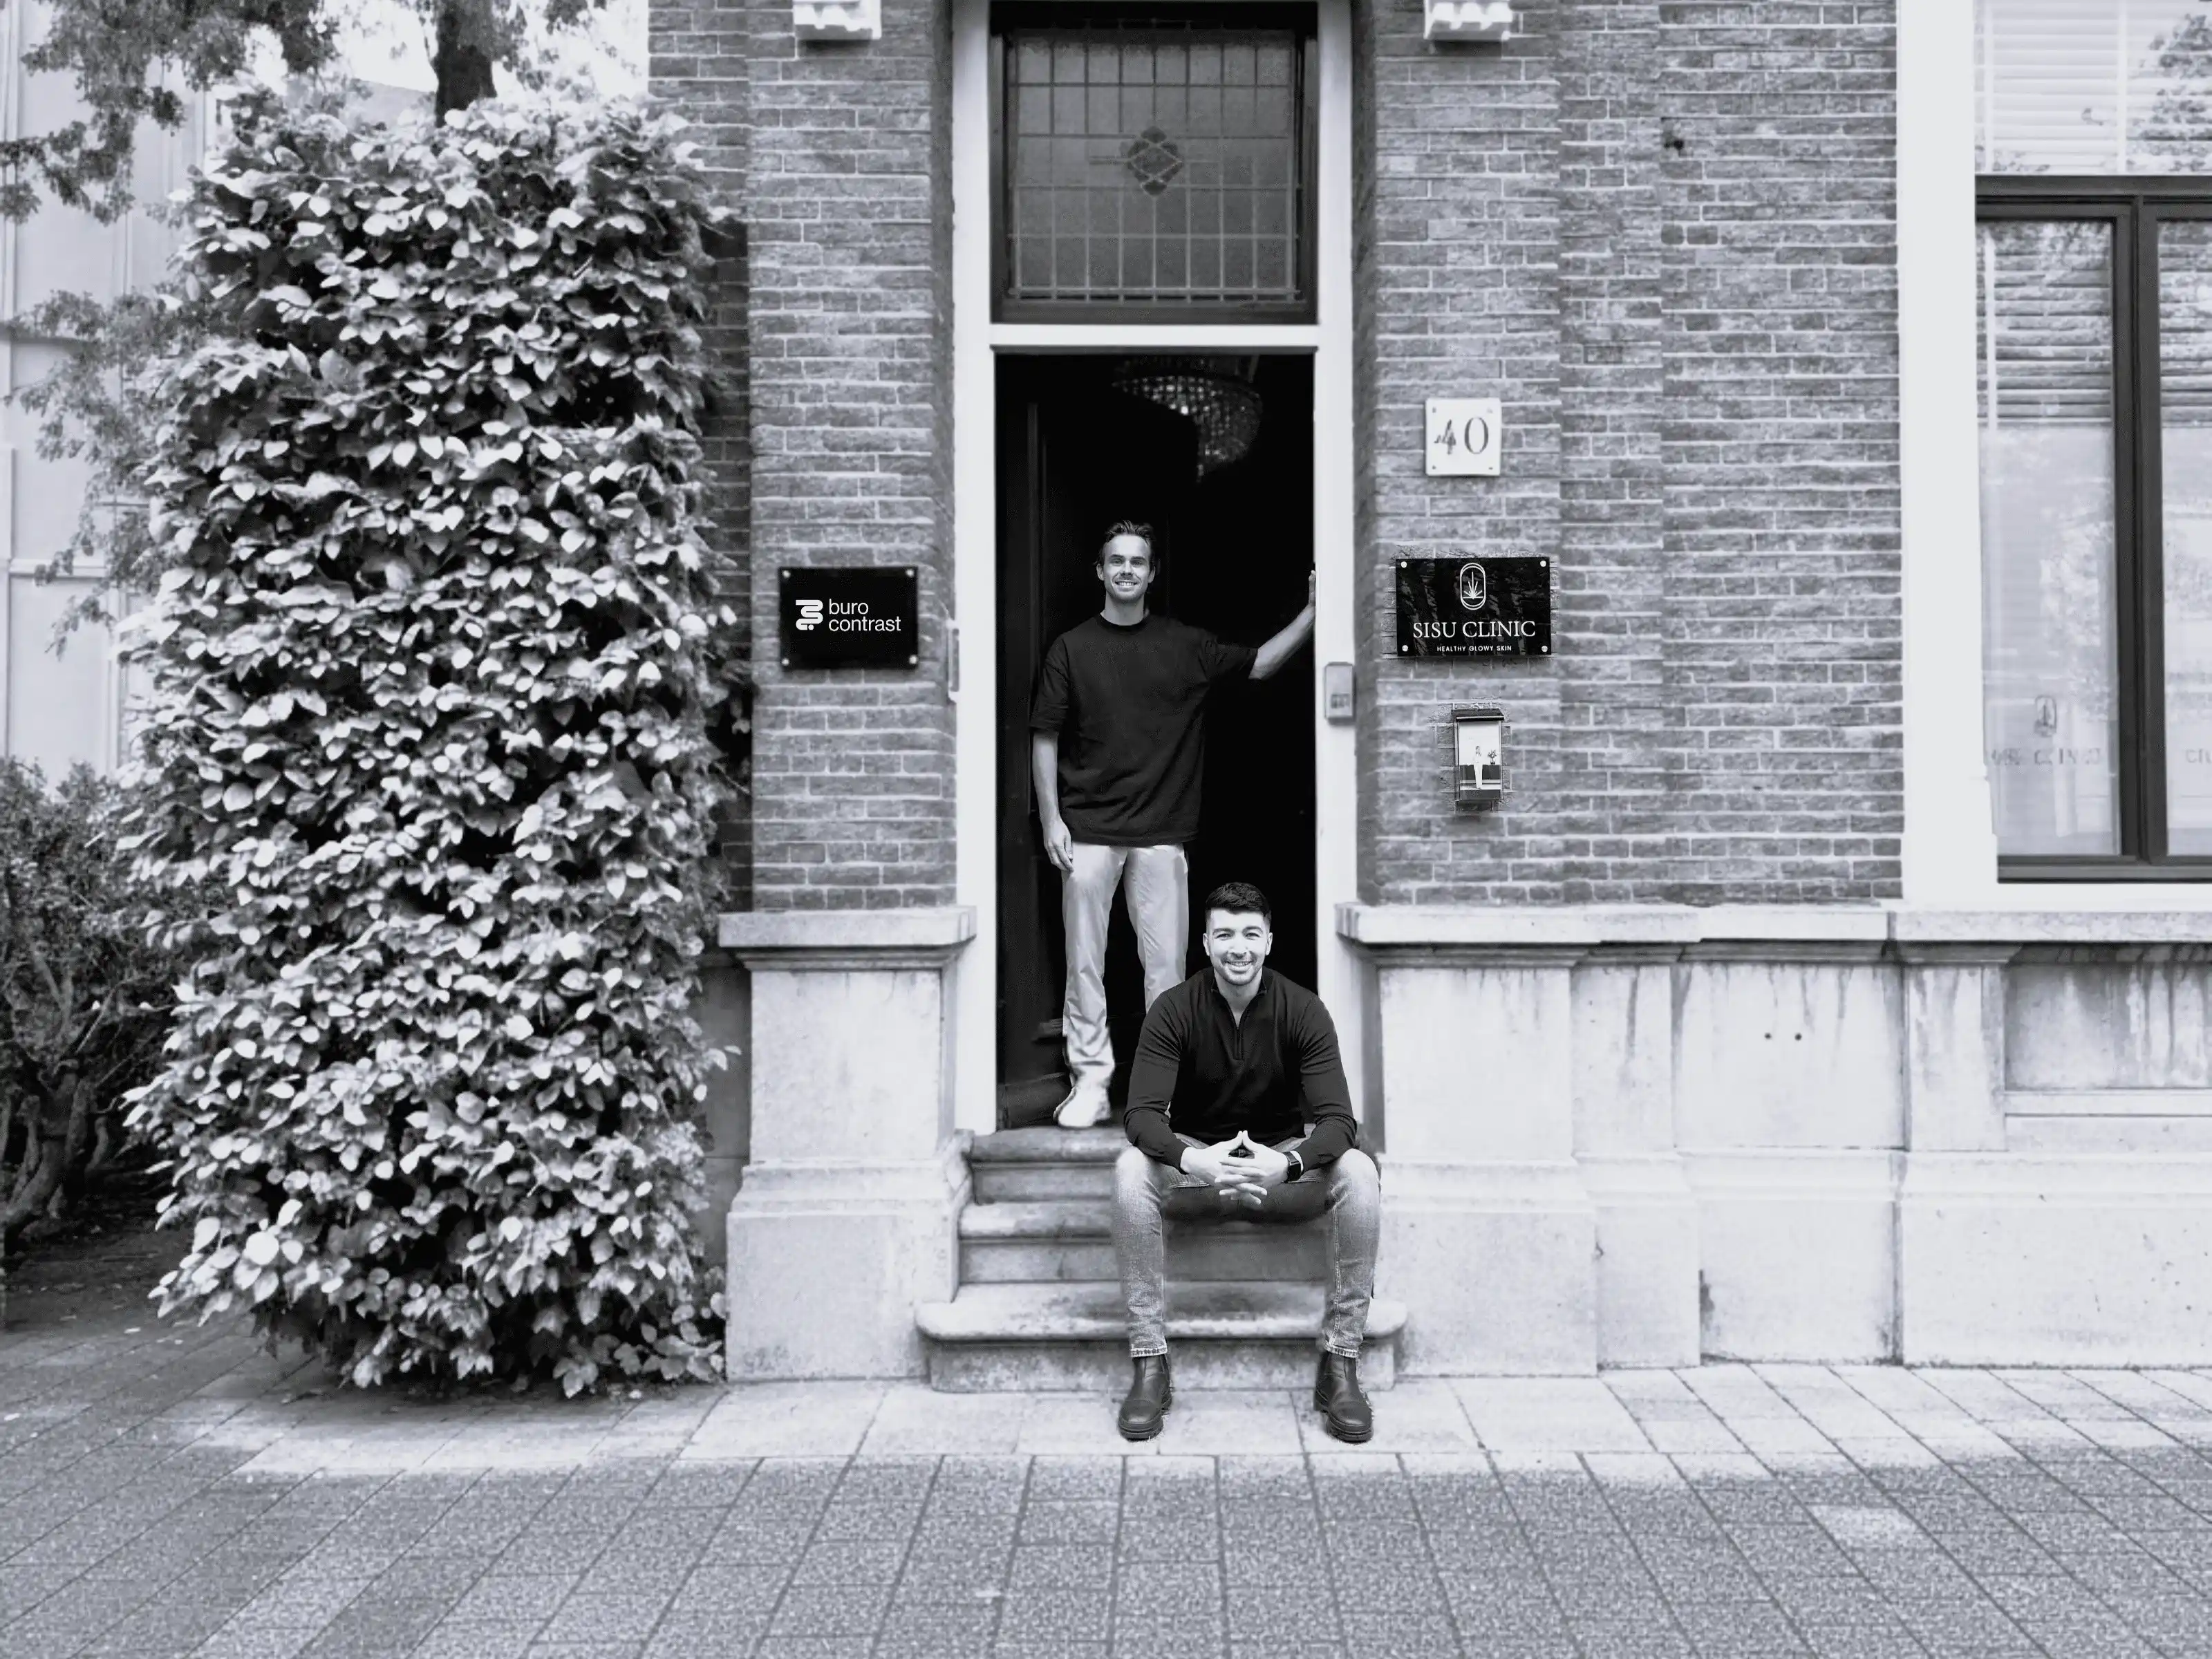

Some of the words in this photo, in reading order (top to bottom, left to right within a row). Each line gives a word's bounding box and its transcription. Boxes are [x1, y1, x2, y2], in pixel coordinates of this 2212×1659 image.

[1434, 417, 1489, 455] 40
[829, 599, 869, 615] buro
[828, 616, 901, 632] contrast
[1413, 621, 1456, 638] SISU
[1462, 621, 1536, 637] CLINIC
